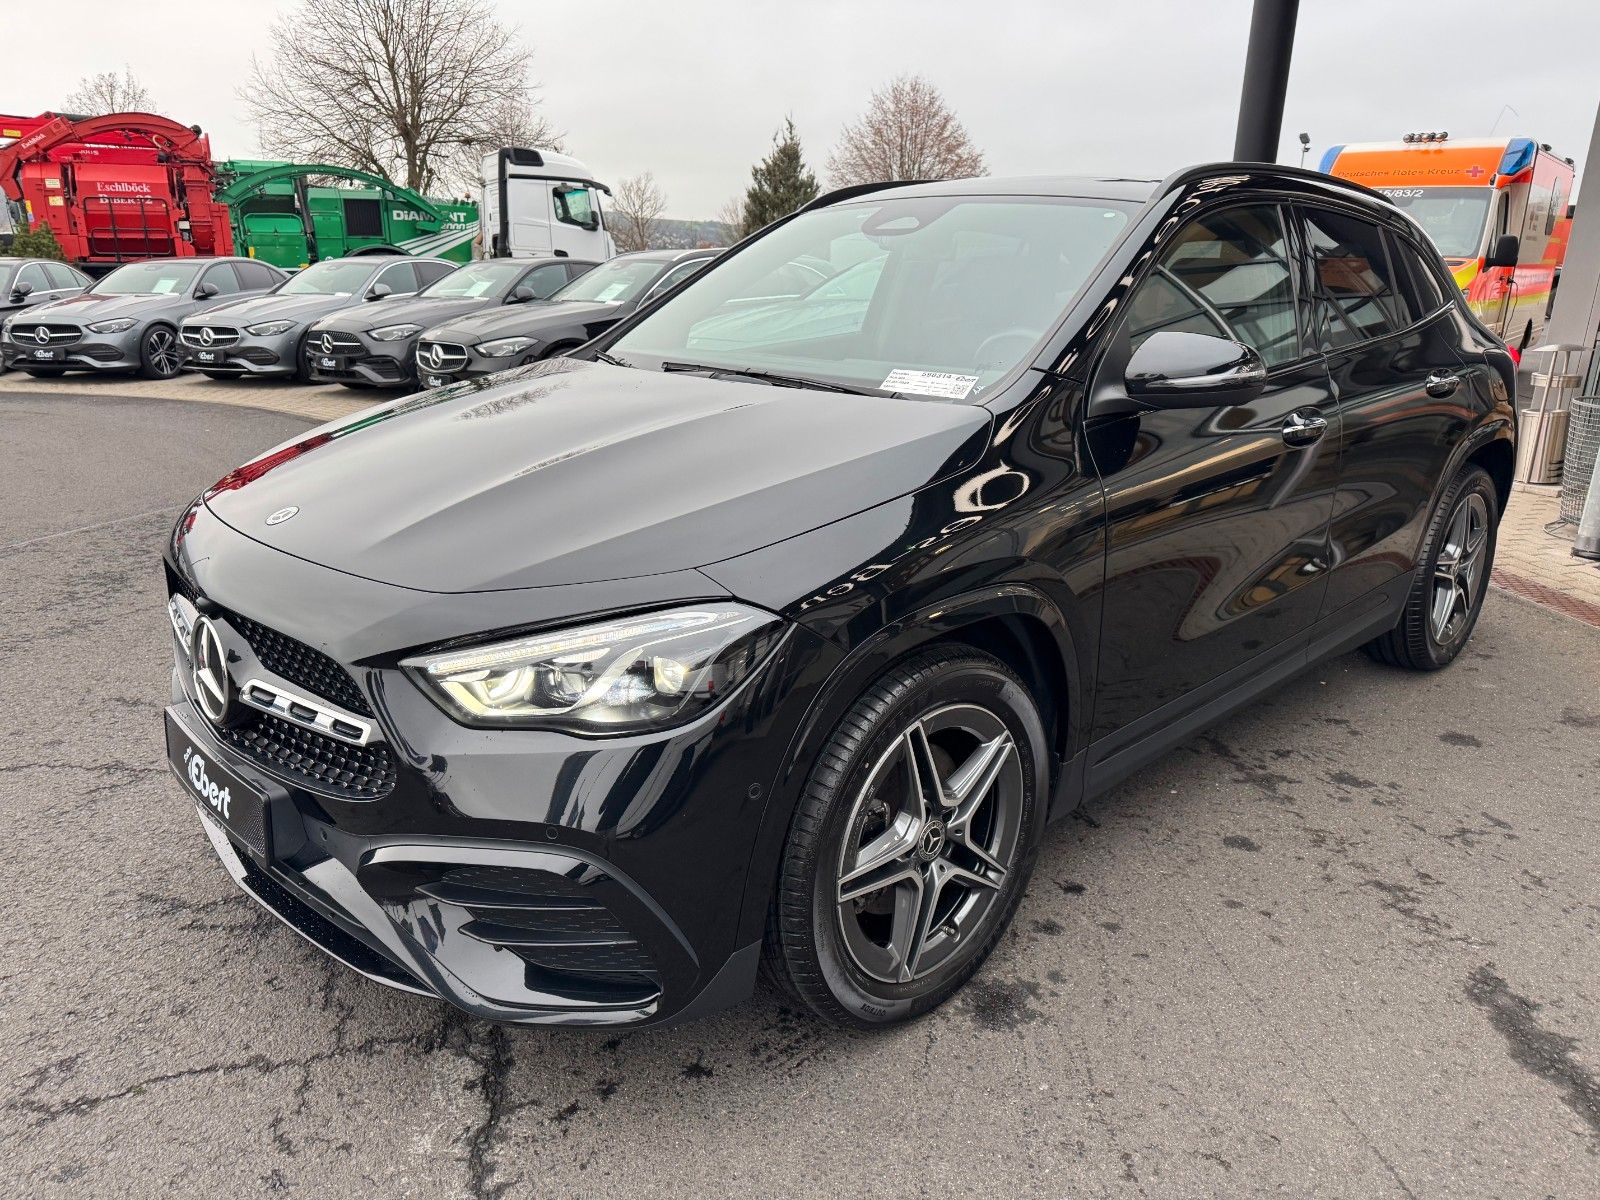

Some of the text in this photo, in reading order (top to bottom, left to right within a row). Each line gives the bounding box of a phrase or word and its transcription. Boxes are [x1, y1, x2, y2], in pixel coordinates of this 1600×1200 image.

[97, 182, 152, 193] Eschlböck
[1379, 189, 1424, 198] 5/83/2
[187, 753, 232, 820] Ebert
